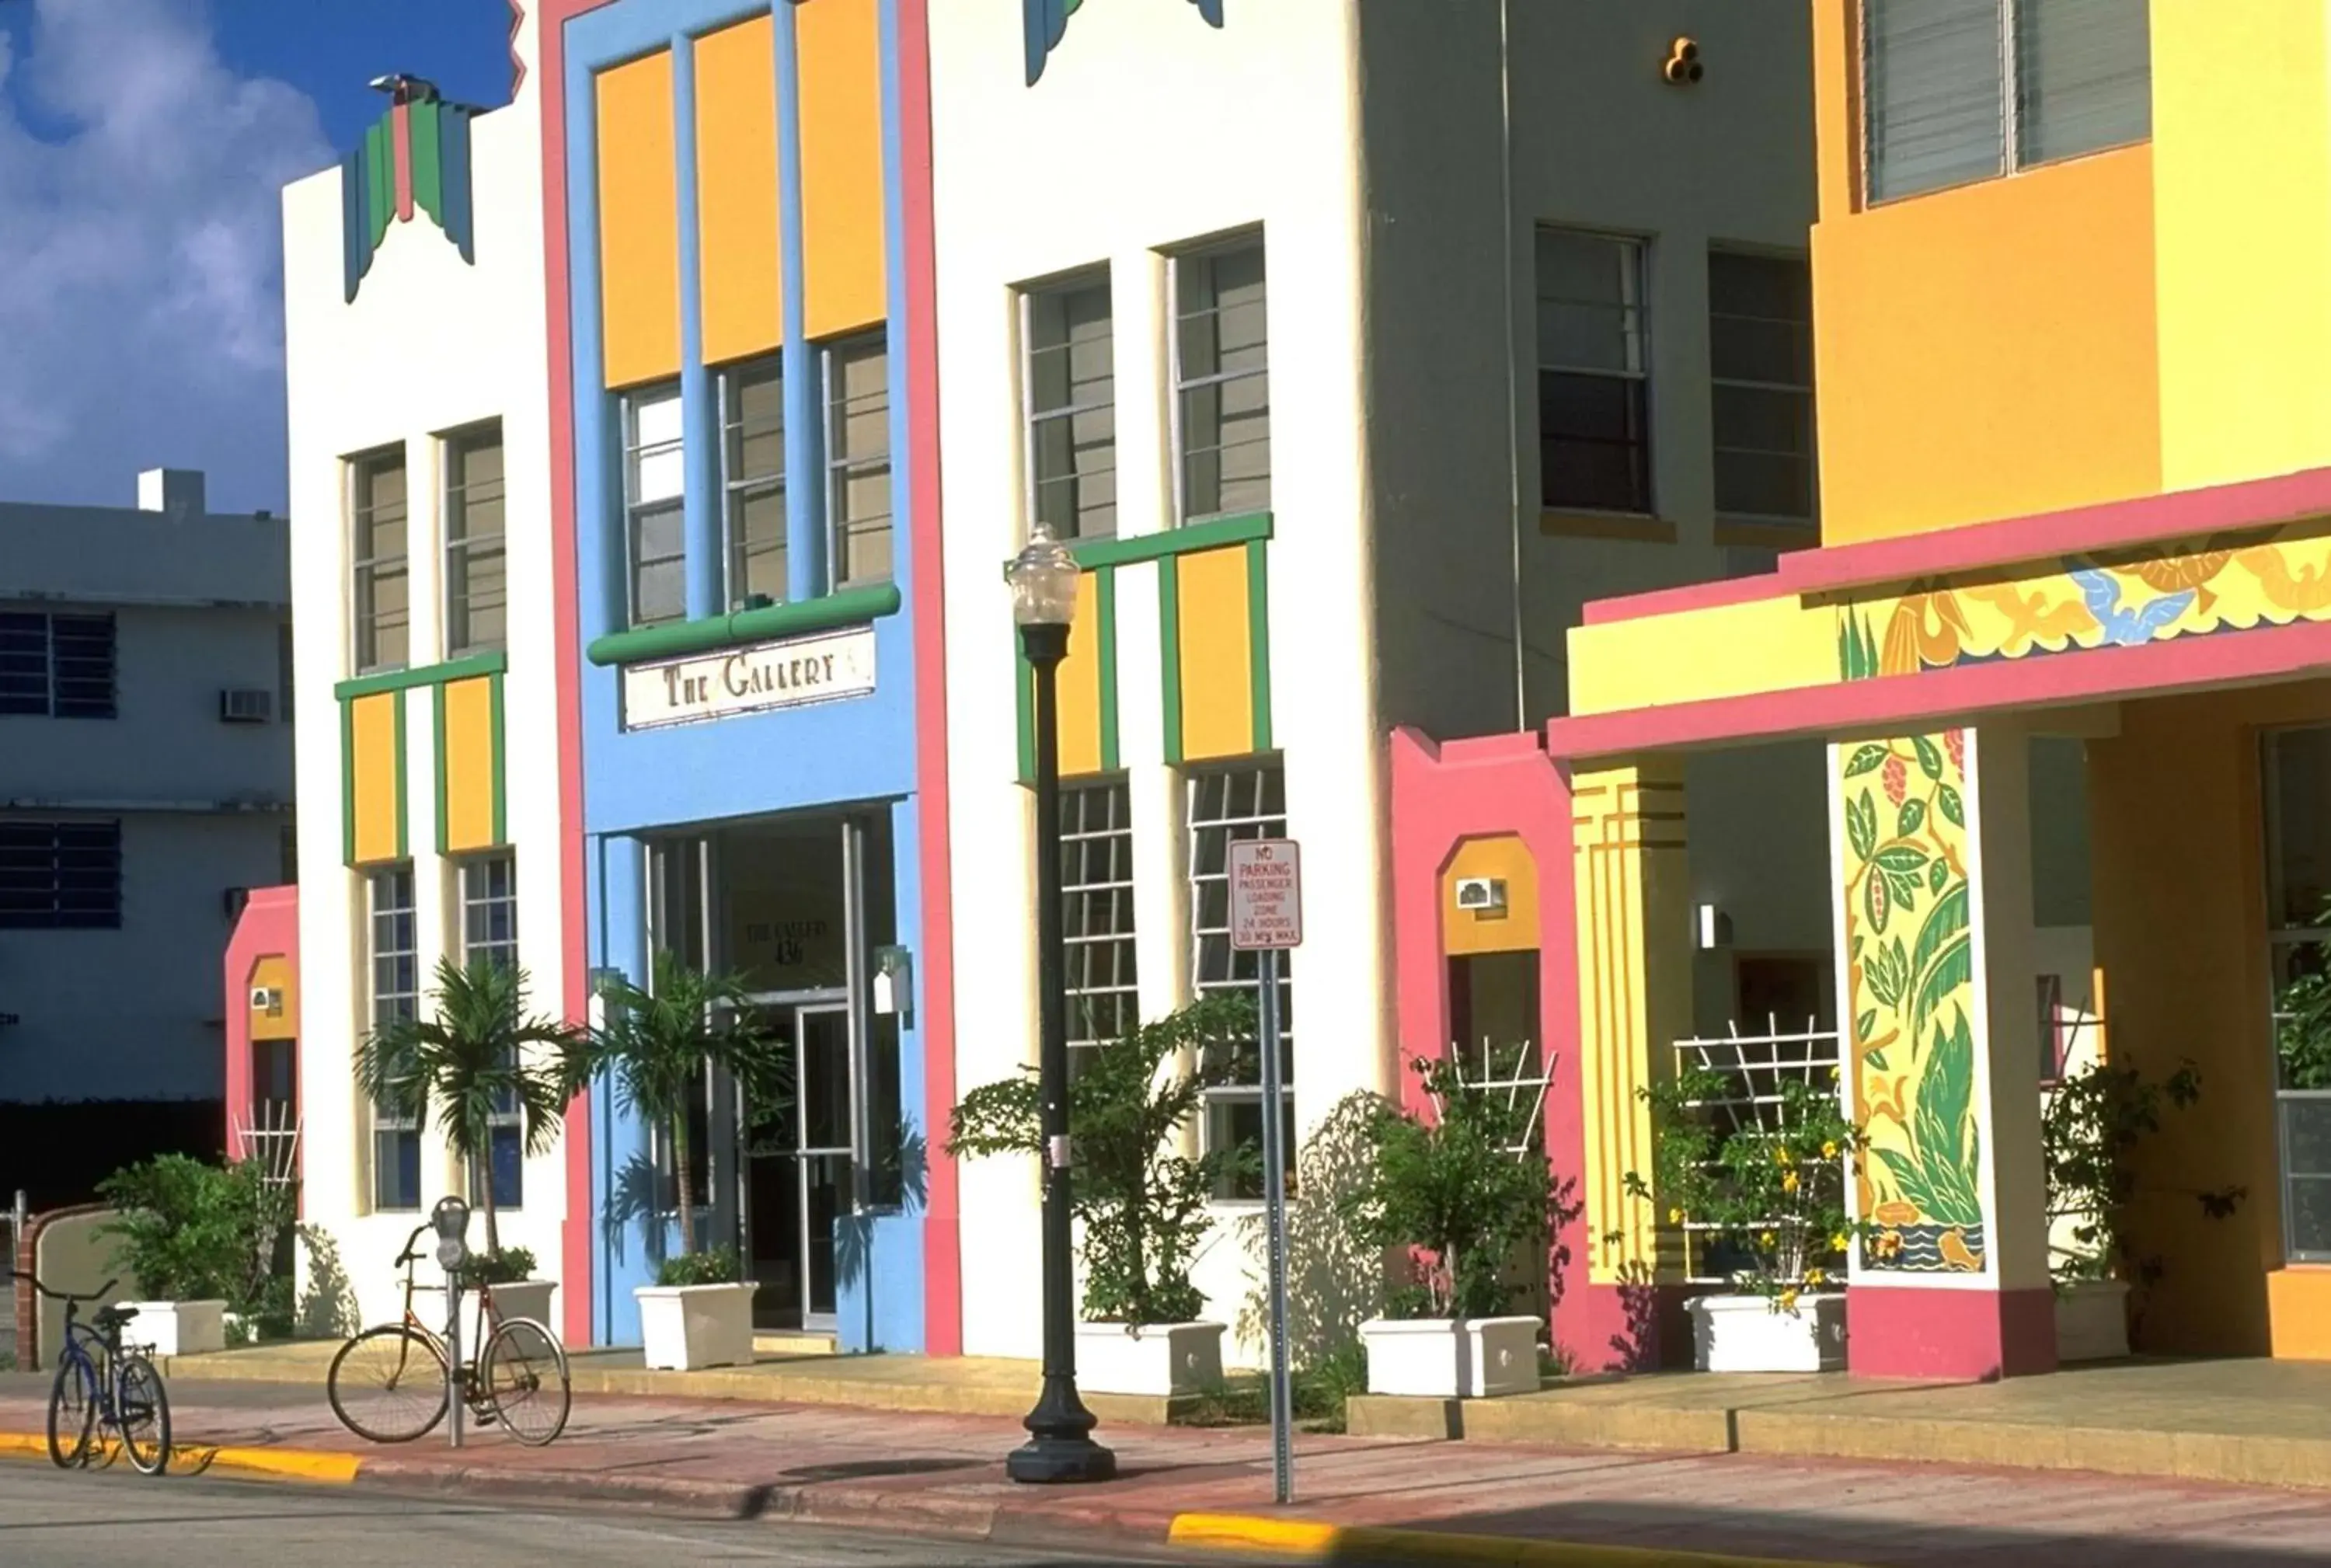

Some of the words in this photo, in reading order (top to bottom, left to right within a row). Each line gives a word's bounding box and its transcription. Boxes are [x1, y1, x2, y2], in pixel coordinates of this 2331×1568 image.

[723, 653, 834, 697] GALLERY
[1255, 845, 1274, 860] NO
[1239, 861, 1291, 876] PARKING
[1239, 877, 1292, 889] PASSENGER
[1246, 890, 1286, 903] LOADING
[1253, 904, 1277, 915] ZONE
[1243, 917, 1256, 929] 24
[1258, 916, 1291, 928] HOURS
